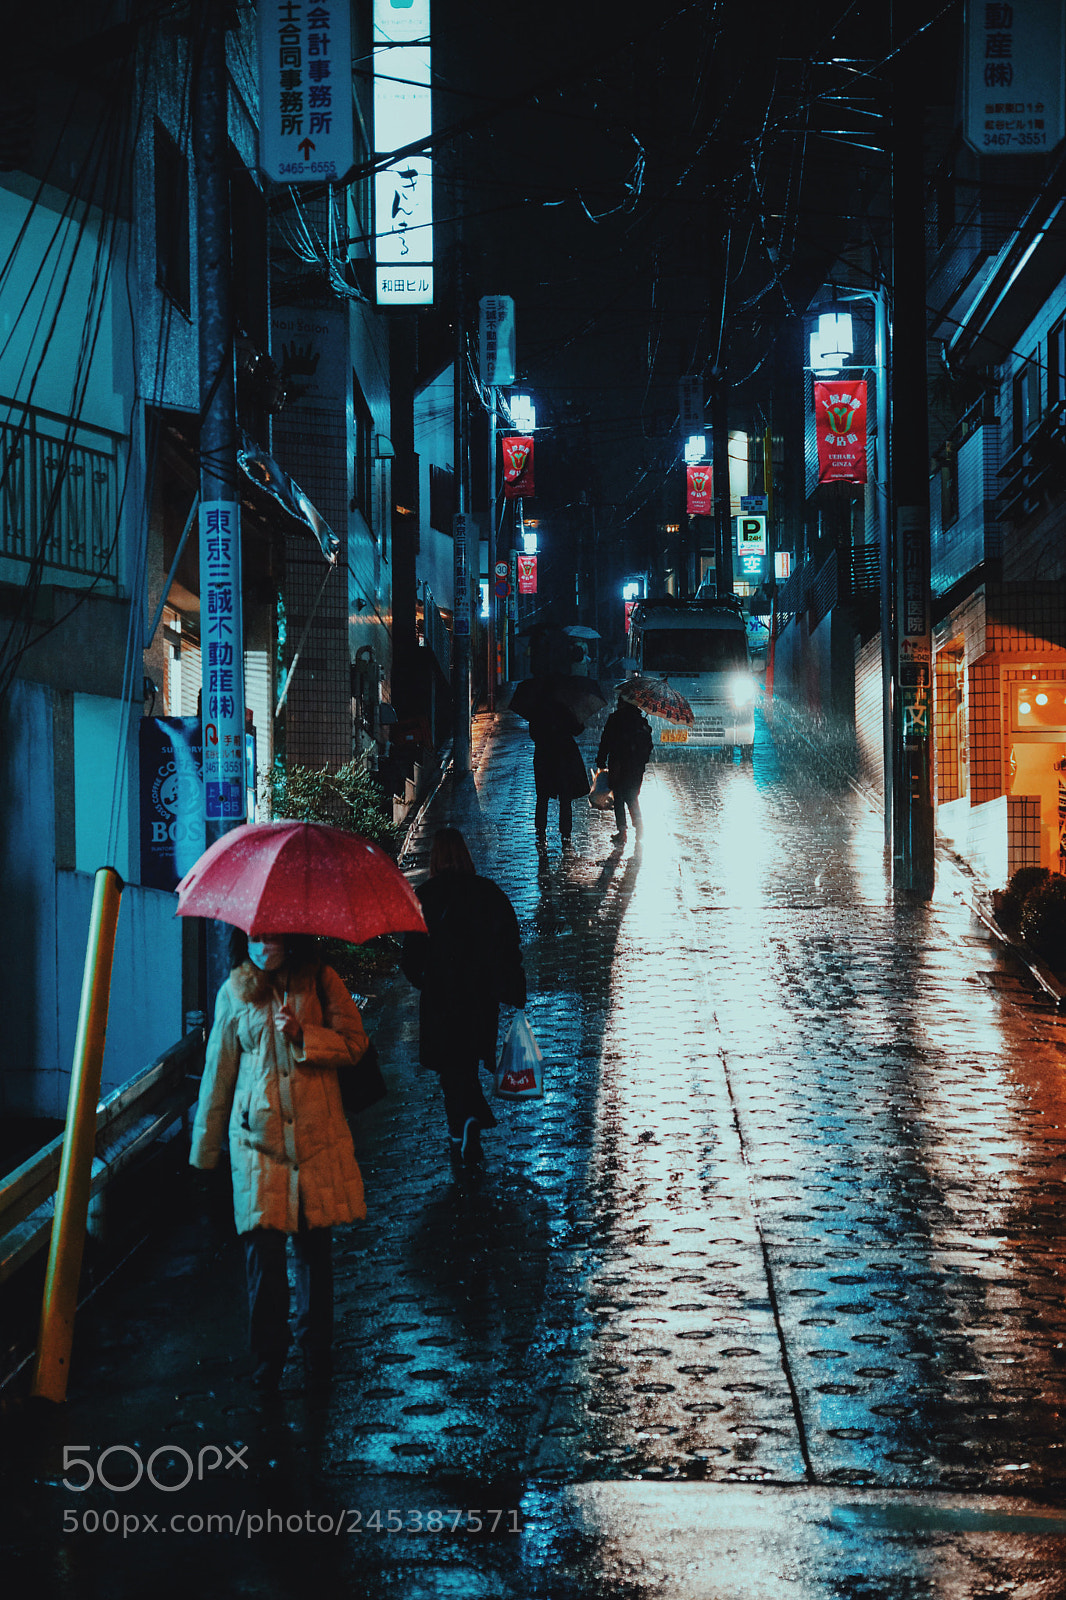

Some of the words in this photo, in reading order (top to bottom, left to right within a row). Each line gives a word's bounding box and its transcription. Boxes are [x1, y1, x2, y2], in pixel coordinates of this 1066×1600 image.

[306, 0, 332, 135] 会計事務所
[984, 133, 1047, 146] 3467-3551
[278, 161, 337, 175] 3465-6555
[742, 519, 761, 541] P
[496, 565, 507, 575] 30
